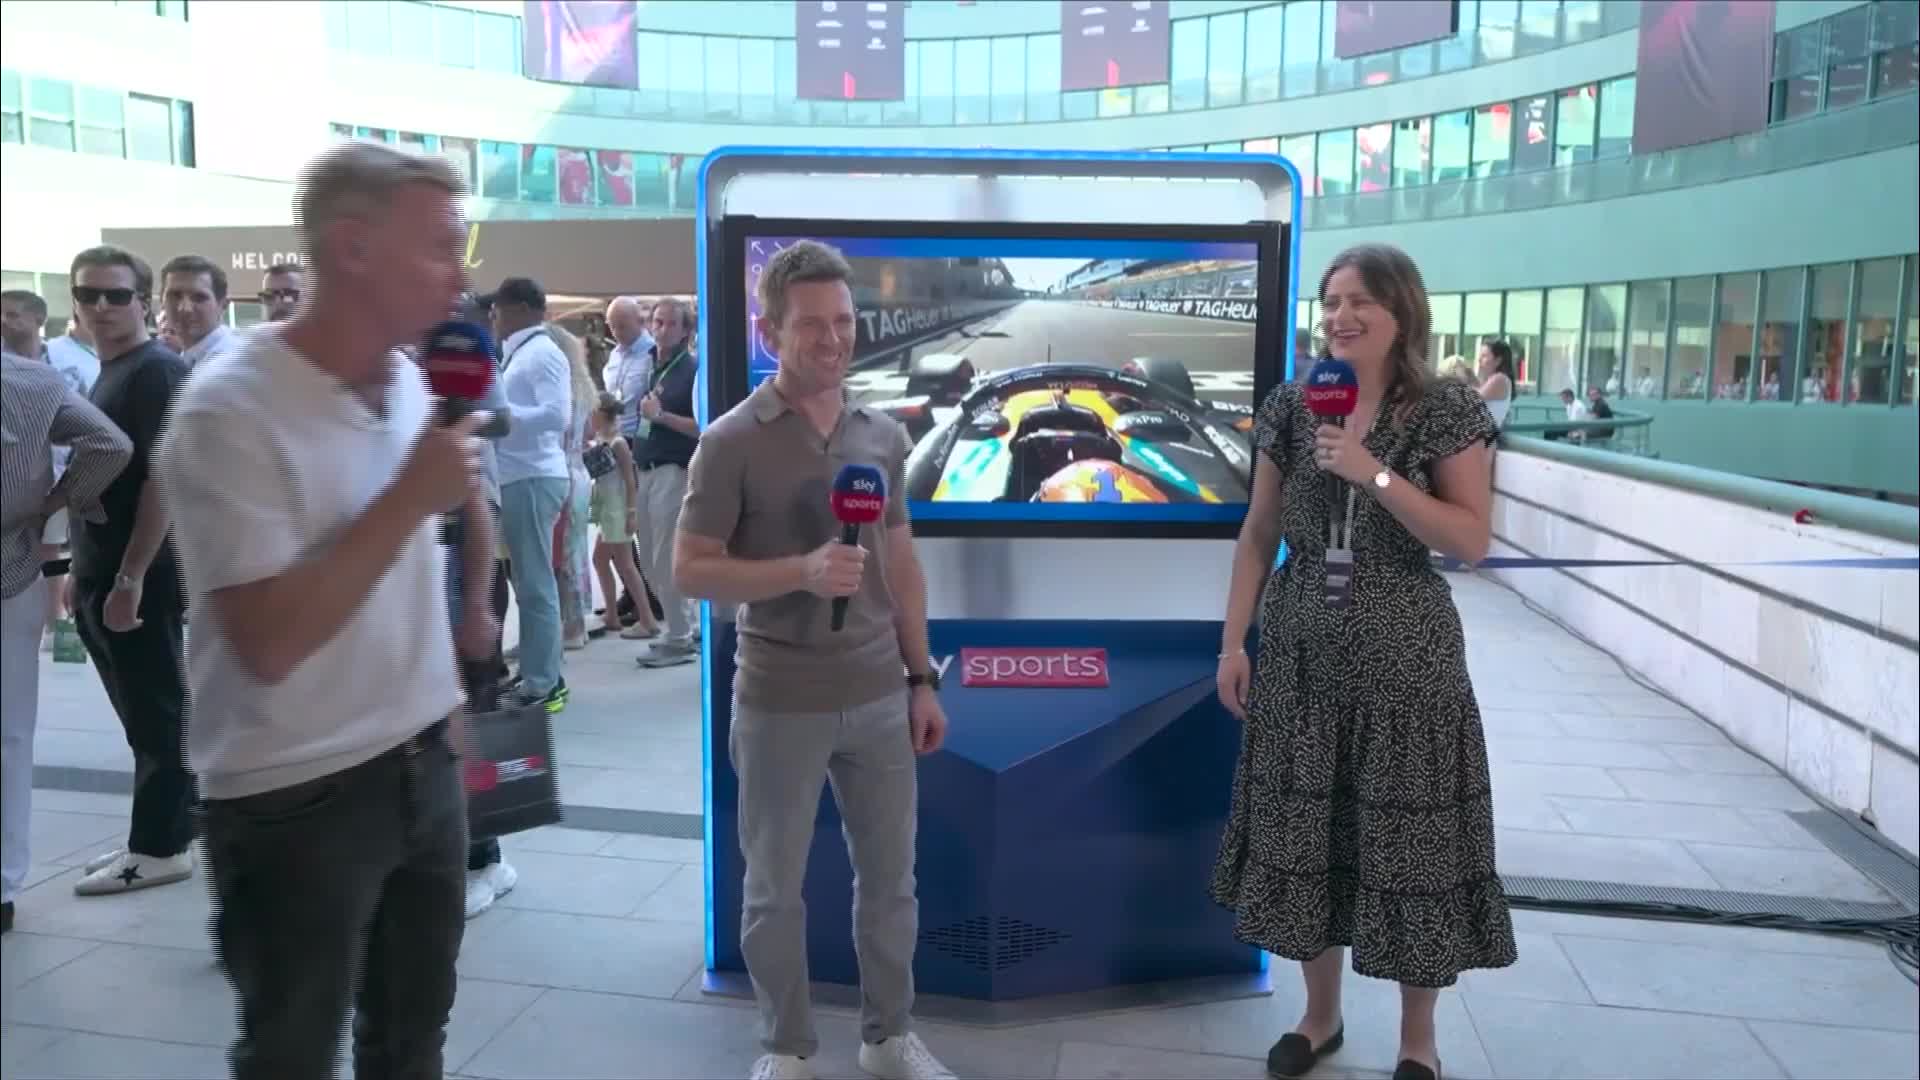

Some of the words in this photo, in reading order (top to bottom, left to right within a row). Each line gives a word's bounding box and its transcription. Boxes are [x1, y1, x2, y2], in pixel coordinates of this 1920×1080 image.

[1316, 372, 1341, 385] sky
[1310, 390, 1348, 401] sports
[852, 479, 876, 494] sky
[843, 498, 881, 511] sports
[970, 652, 1101, 681] sports
